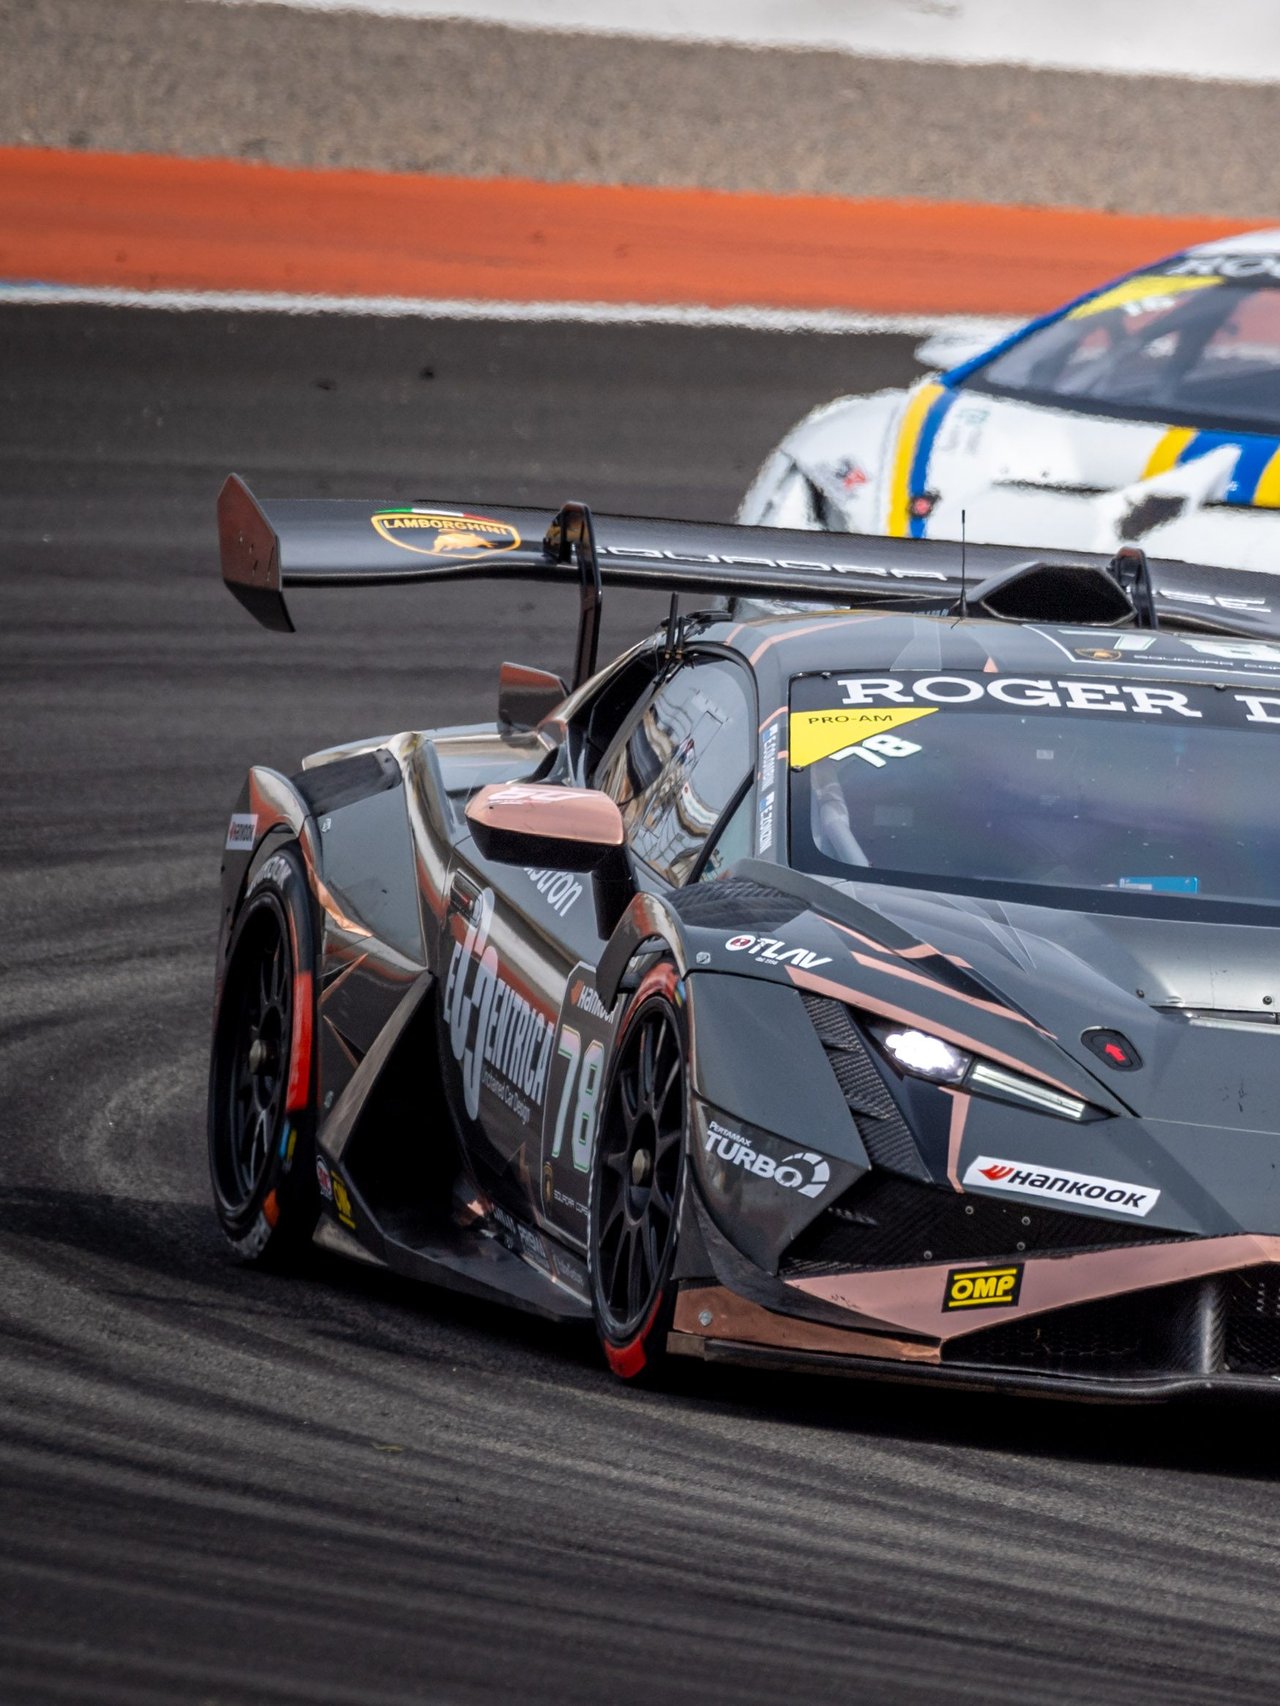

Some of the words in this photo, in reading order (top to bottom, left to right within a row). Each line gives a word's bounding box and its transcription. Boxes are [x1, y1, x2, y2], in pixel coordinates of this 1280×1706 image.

[383, 518, 507, 535] LAMBORGHINI
[837, 676, 1203, 718] ROGER
[807, 713, 893, 726] PRO-AM
[829, 734, 923, 768] 78
[725, 934, 833, 969] OTLAV
[551, 1023, 605, 1173] 78
[709, 1120, 752, 1147] PERTAMAX
[704, 1130, 803, 1188] TURBO
[951, 1277, 1016, 1300] OMP
